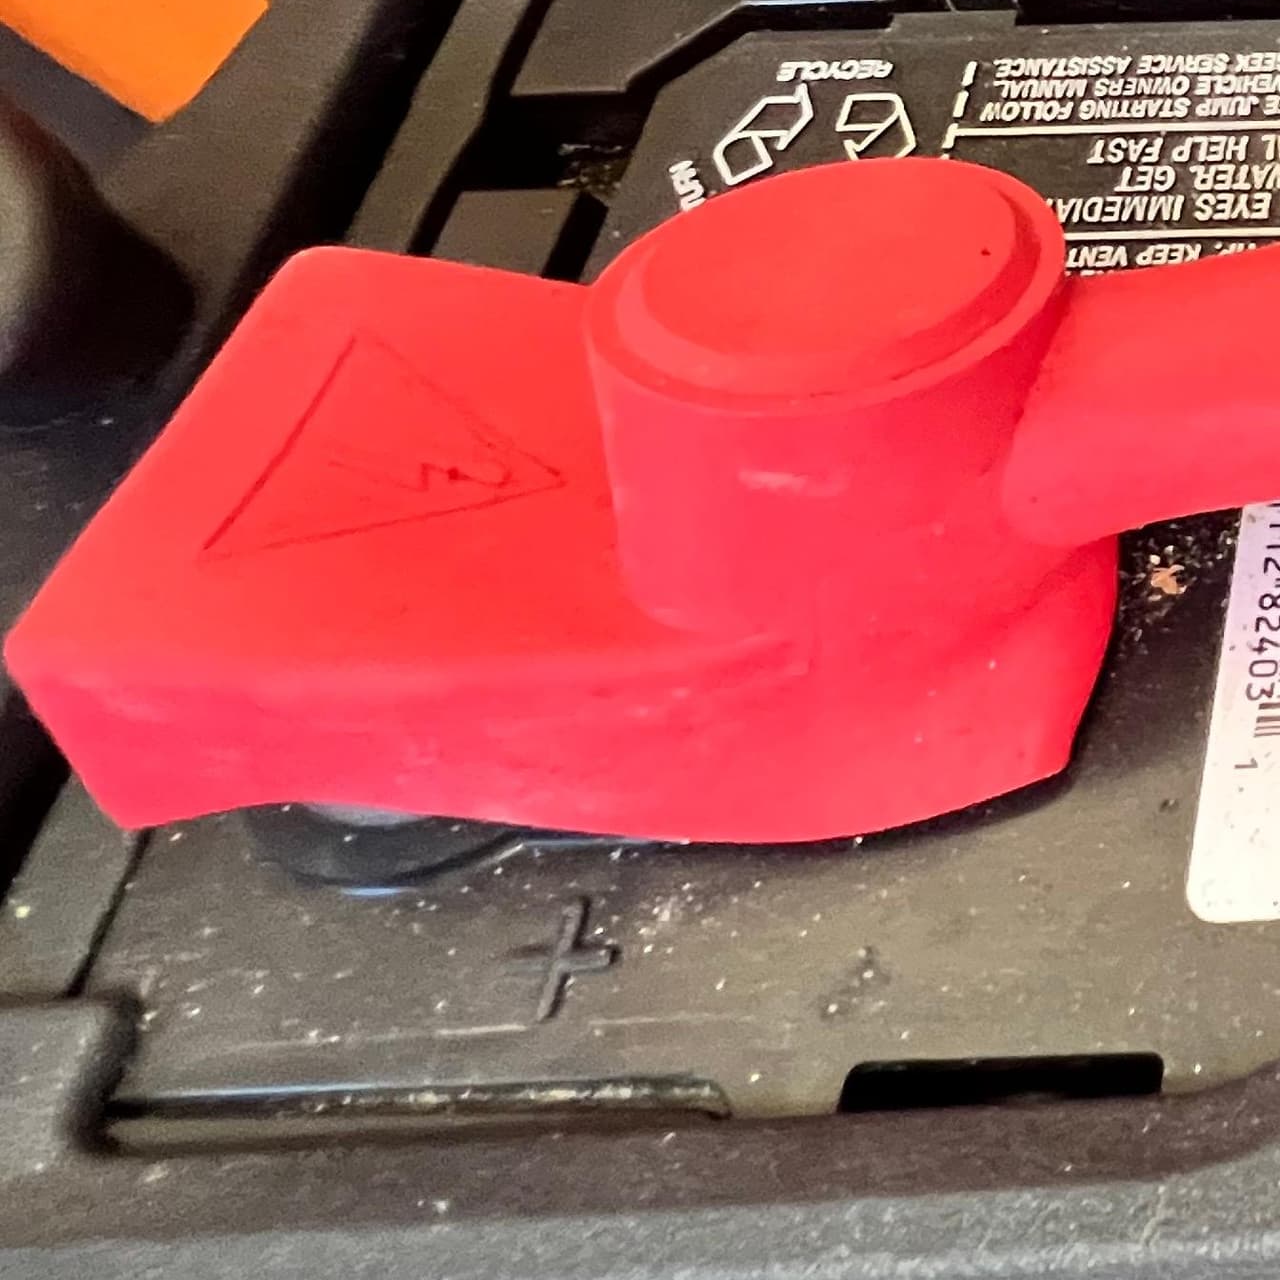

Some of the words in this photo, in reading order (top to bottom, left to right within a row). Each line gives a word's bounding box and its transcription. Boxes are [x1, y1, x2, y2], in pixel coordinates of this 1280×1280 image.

[776, 59, 894, 82] RECYCLE
[1137, 53, 1230, 74] SERVICE
[1094, 75, 1190, 97] OWNERS
[979, 100, 1074, 122] FOLLOW
[1078, 97, 1191, 120] STARTING
[1196, 95, 1259, 117] JUMP
[1087, 137, 1163, 165] FAST
[1172, 135, 1249, 162] HELP
[1114, 165, 1176, 192] GET
[1045, 194, 1184, 223] IMMEDIA
[1195, 191, 1272, 220] EYES
